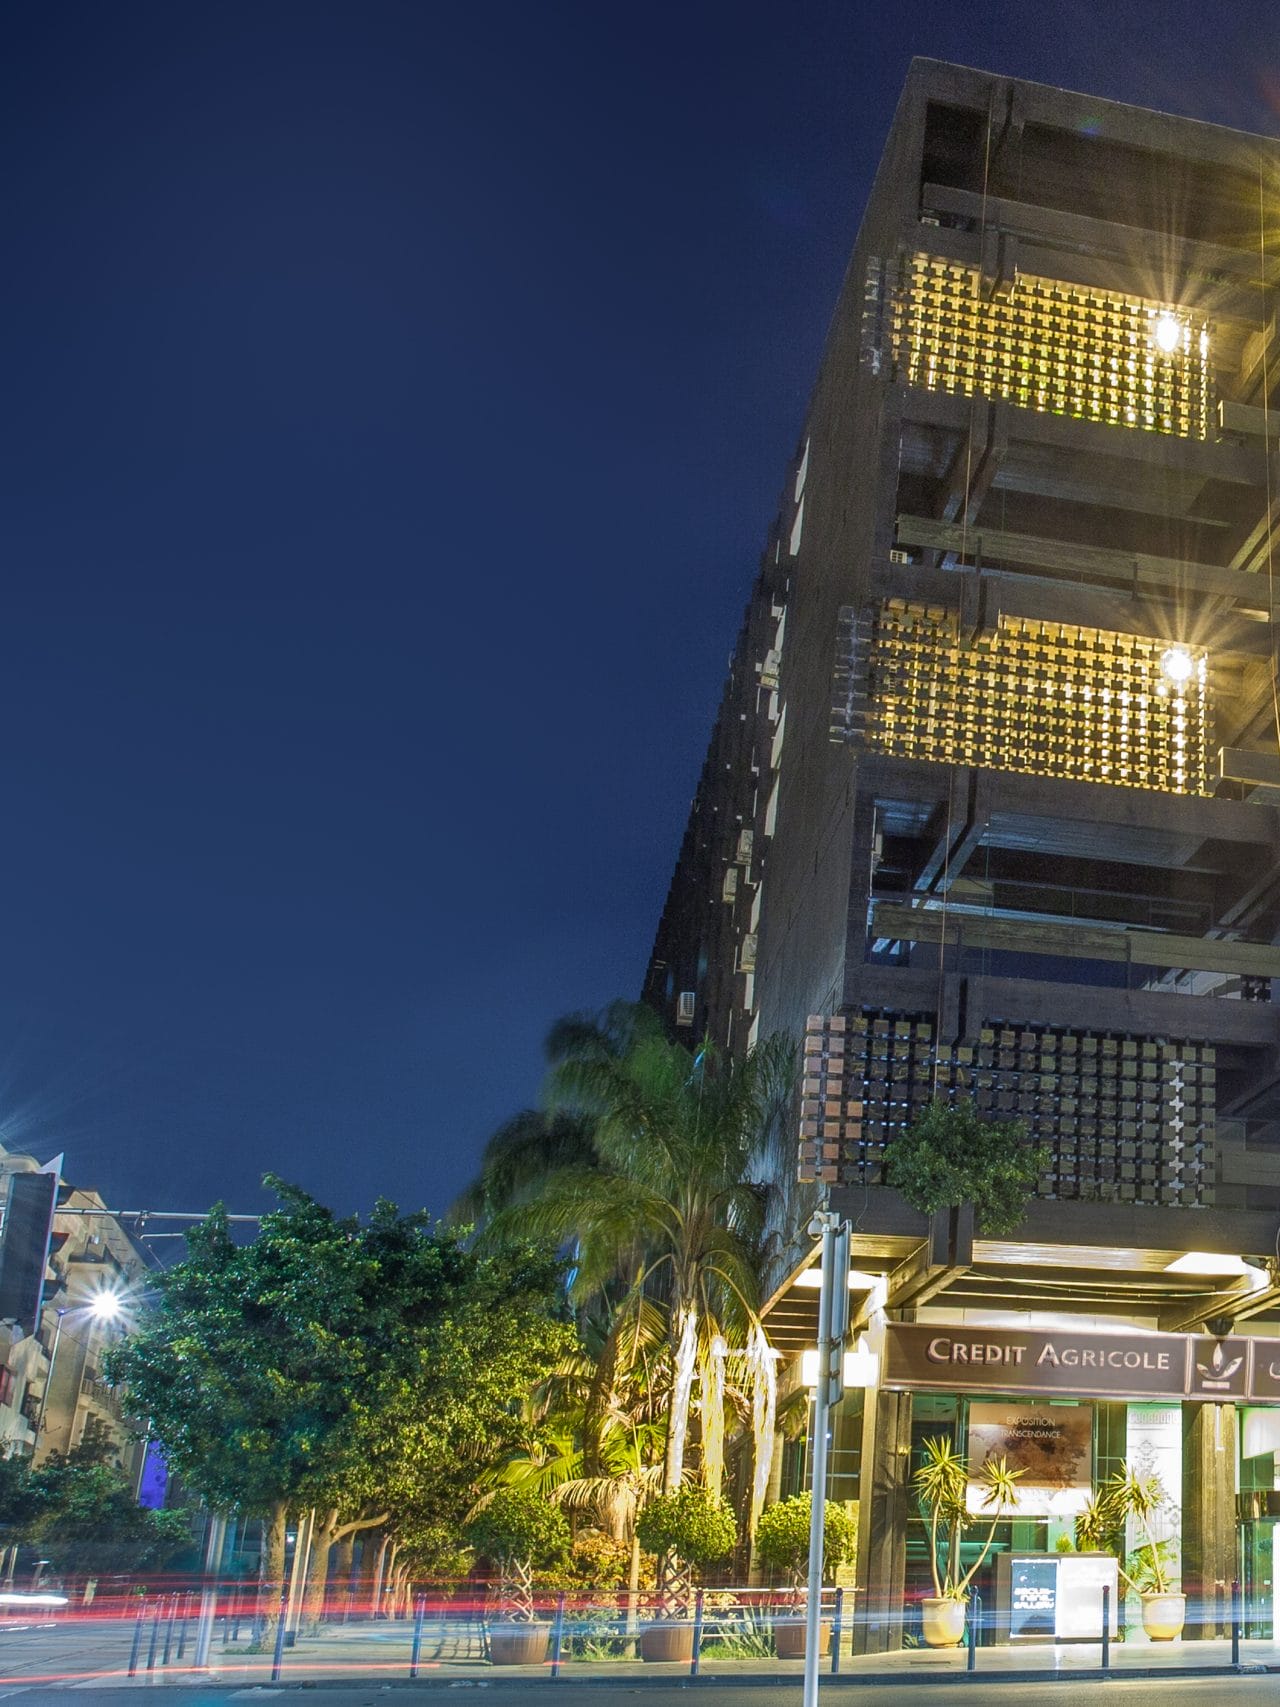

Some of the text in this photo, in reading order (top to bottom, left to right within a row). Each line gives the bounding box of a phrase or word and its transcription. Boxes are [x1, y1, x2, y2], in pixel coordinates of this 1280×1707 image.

[928, 1338, 1170, 1370] CREDIT AGRICOLE
[1006, 1416, 1056, 1427] EXPOSITION
[1001, 1430, 1062, 1439] TRANSCENDANCE
